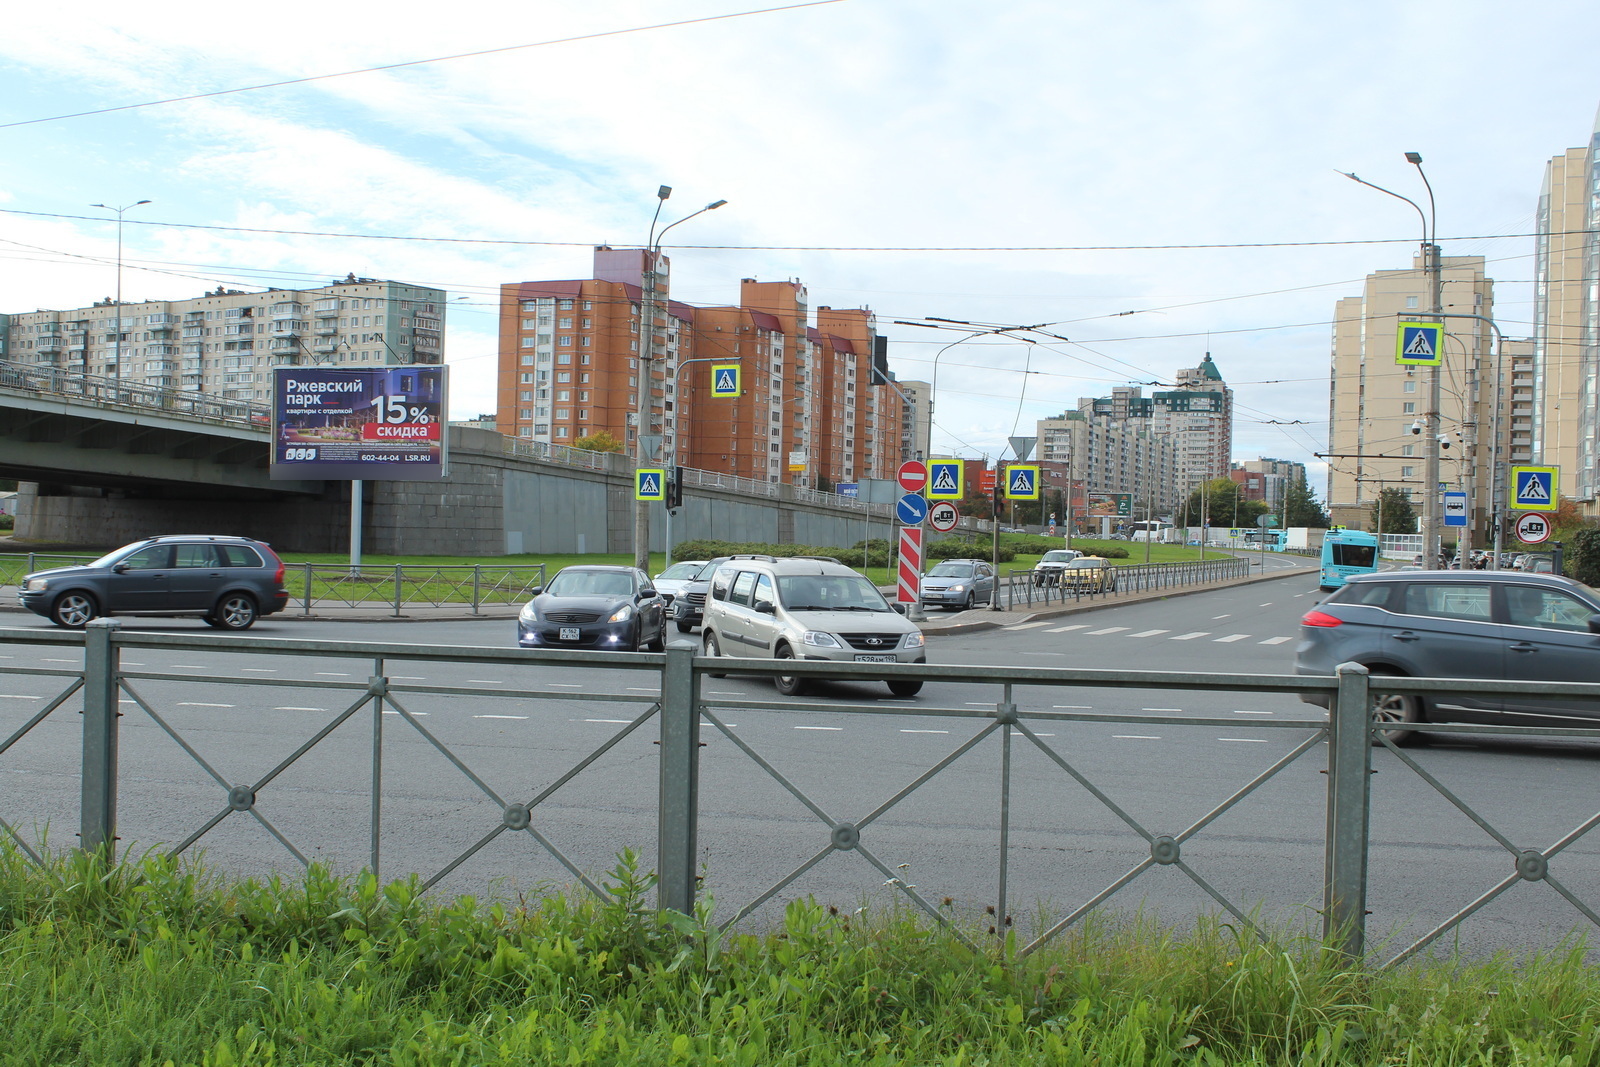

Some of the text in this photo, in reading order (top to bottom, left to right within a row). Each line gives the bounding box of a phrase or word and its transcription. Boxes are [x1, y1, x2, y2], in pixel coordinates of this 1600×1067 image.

[286, 380, 362, 392] Ржевский
[286, 394, 322, 408] парк
[322, 407, 353, 415] отделкой
[370, 395, 429, 425] 15%
[361, 454, 400, 462] 602-44-04
[404, 454, 431, 462] LSR.RU
